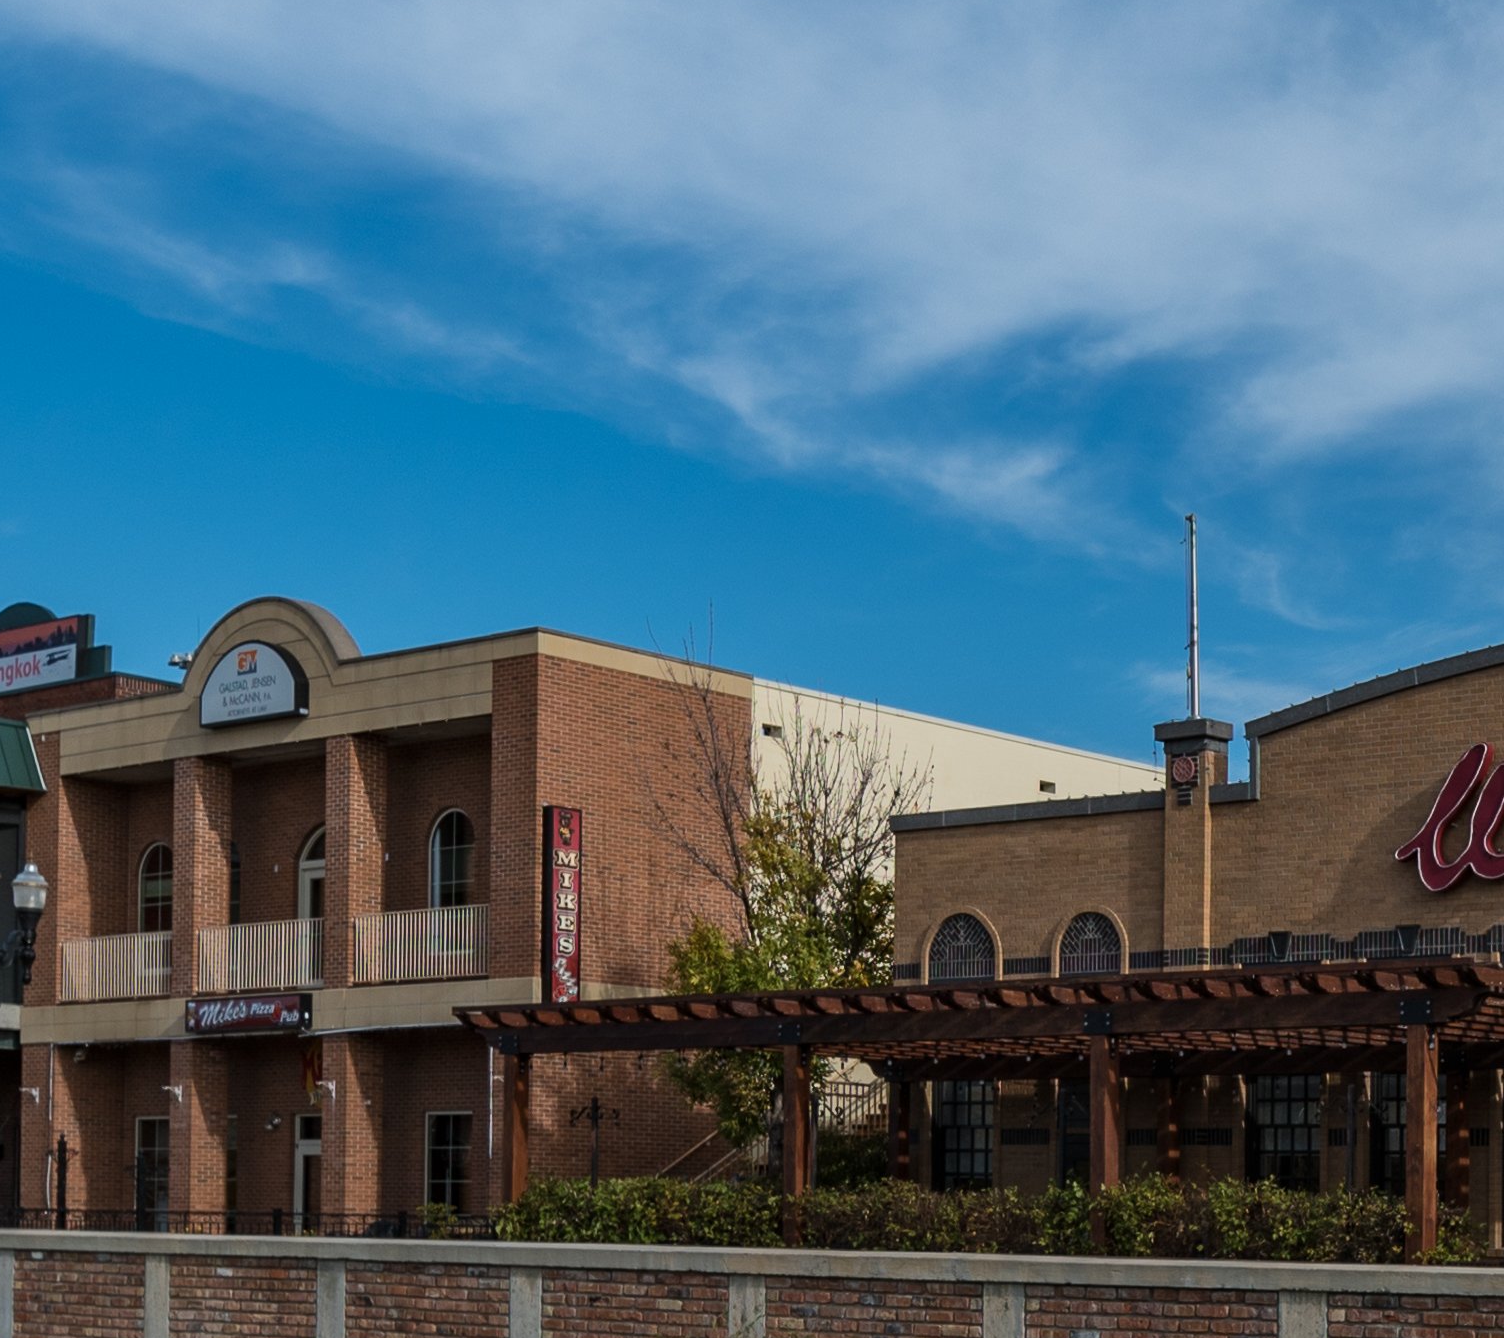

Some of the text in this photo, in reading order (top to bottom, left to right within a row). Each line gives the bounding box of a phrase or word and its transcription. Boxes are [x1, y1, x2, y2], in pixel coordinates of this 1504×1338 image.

[555, 849, 578, 955] MIKES
[199, 999, 300, 1028] Mike's Pizza Pub
